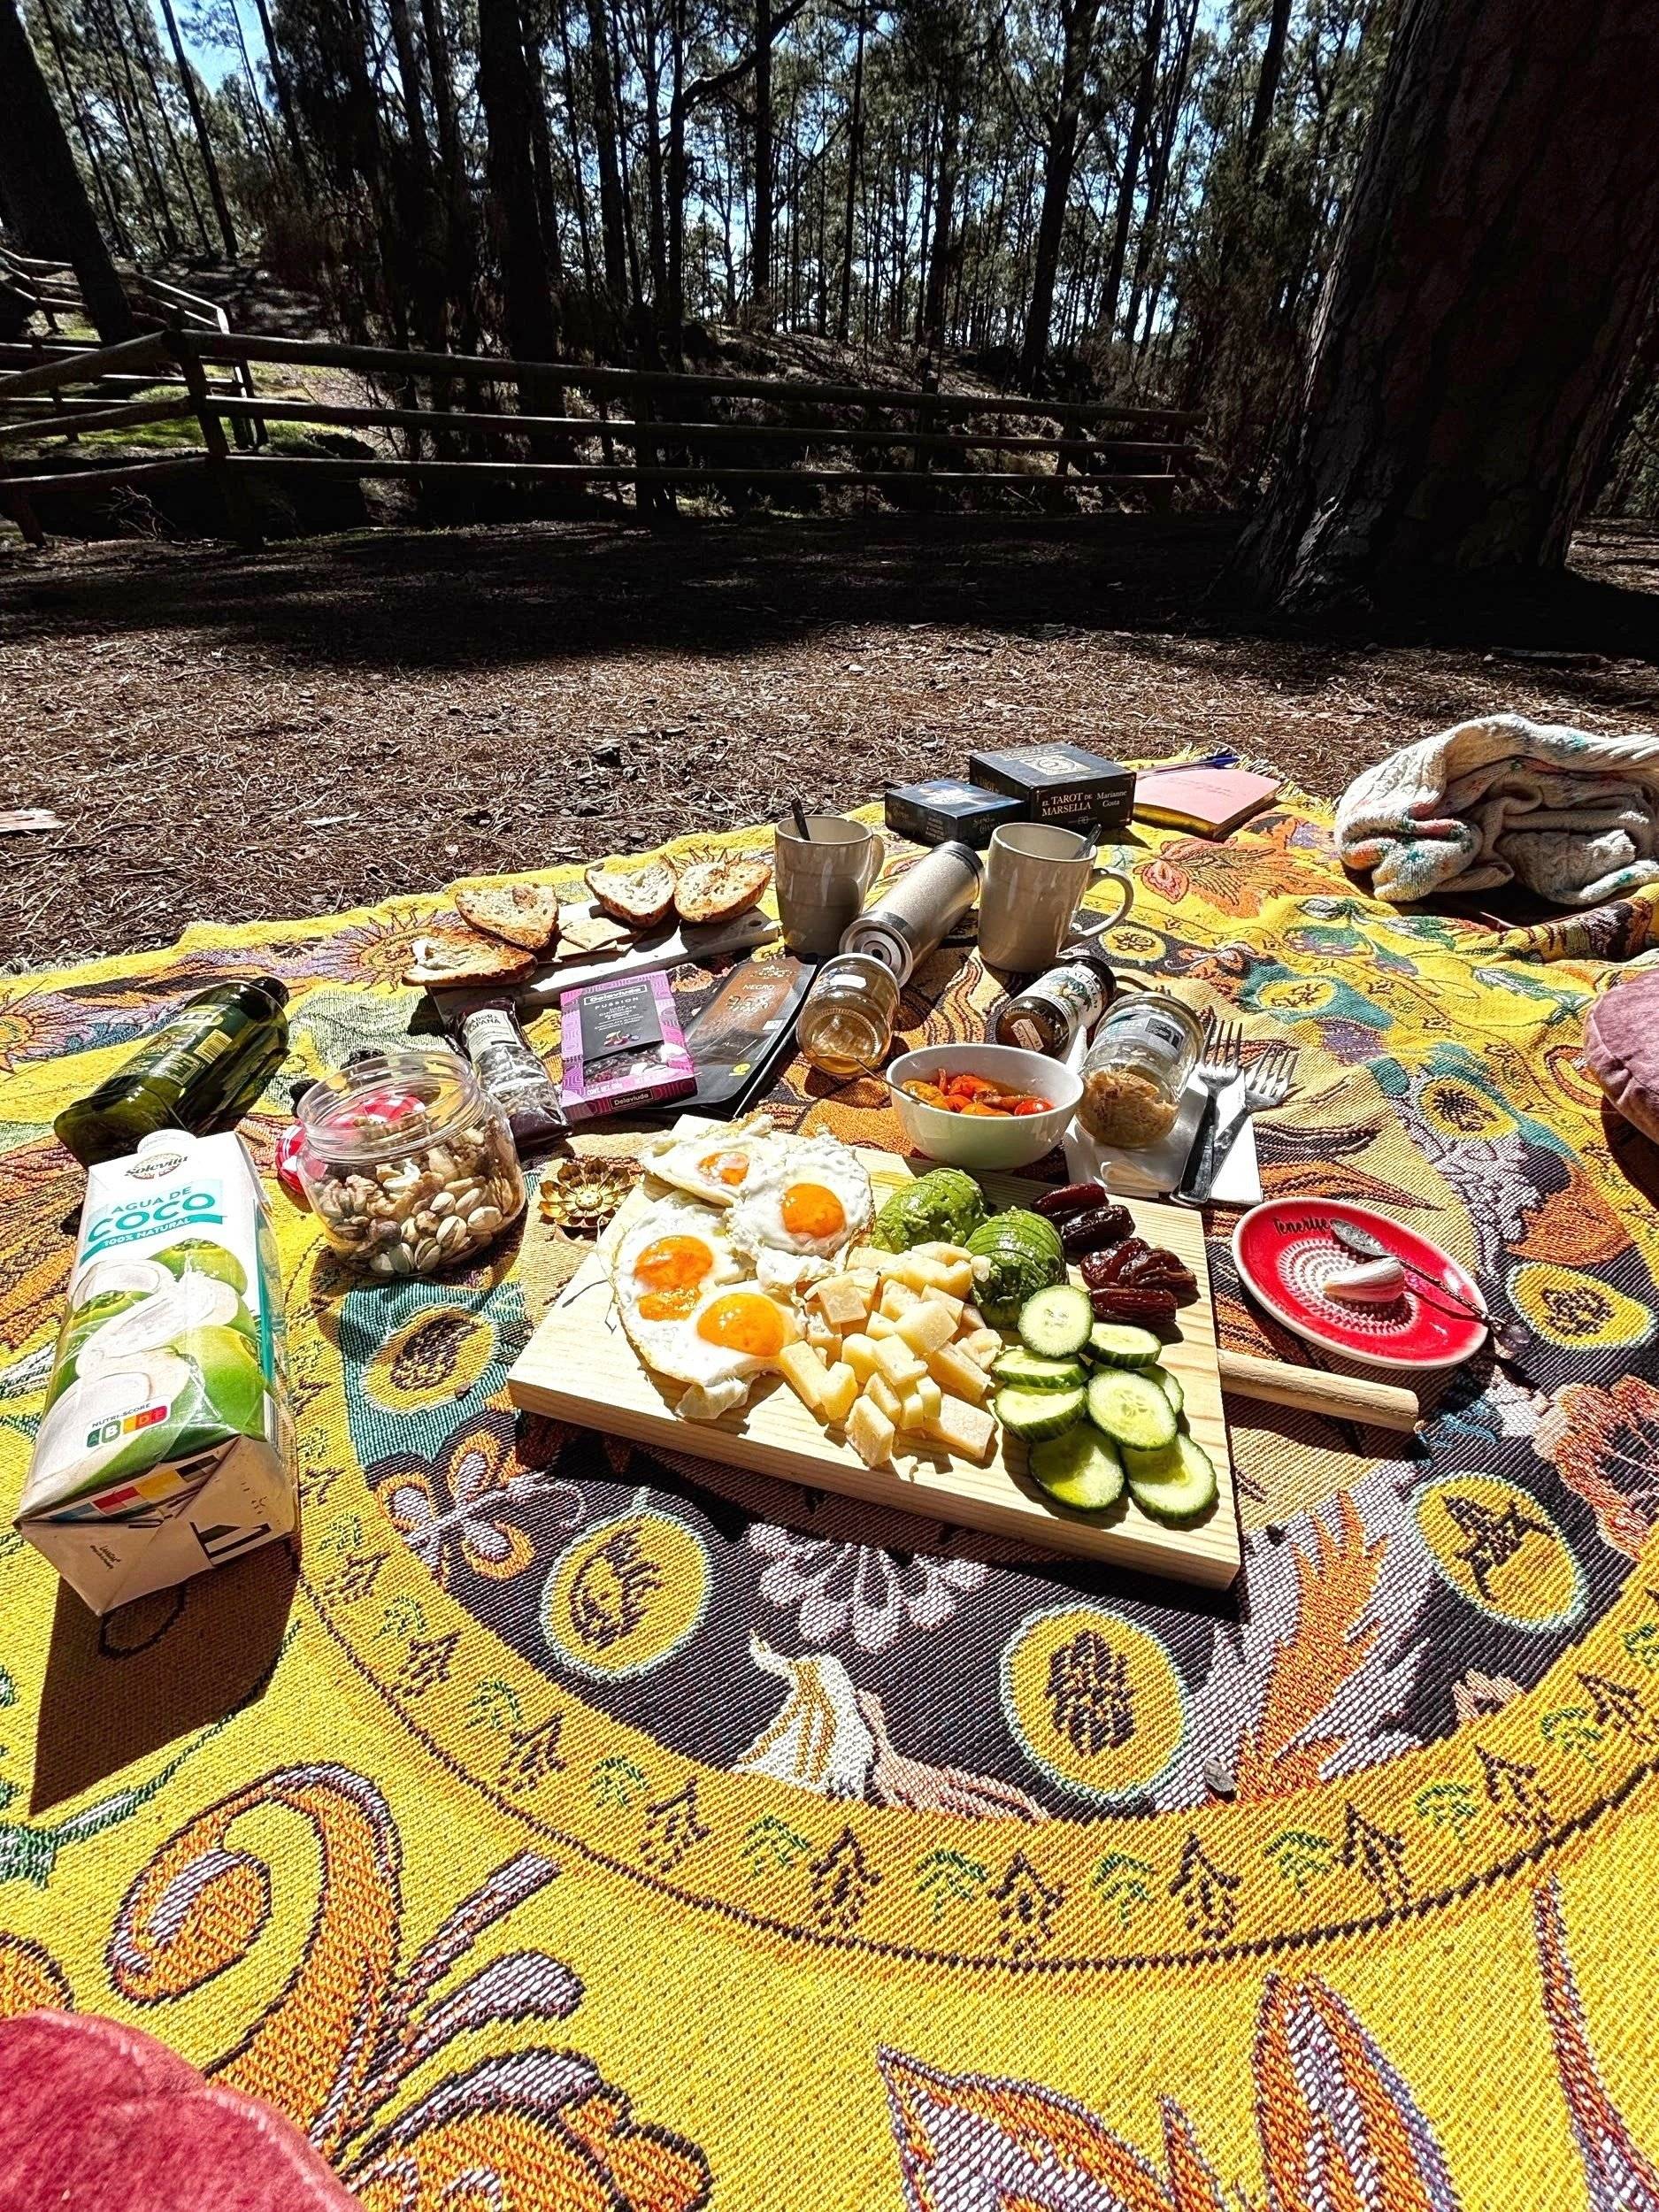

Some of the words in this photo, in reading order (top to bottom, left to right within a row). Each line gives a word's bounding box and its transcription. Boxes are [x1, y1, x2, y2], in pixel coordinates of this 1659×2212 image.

[1051, 792, 1084, 805] TAROT
[1097, 790, 1128, 800] Marianne
[1041, 802, 1093, 817] MARSELLA
[614, 1093, 649, 1106] Delaviuda
[124, 1156, 188, 1177] Solevita
[111, 1196, 164, 1215] AGUA
[169, 1186, 192, 1201] DE
[88, 1193, 215, 1243] COCO
[1271, 1216, 1330, 1236] Tenerife
[103, 1233, 134, 1248] 100%
[136, 1217, 192, 1240] NATURAL
[92, 1402, 151, 1428] NUTRI-SCORE
